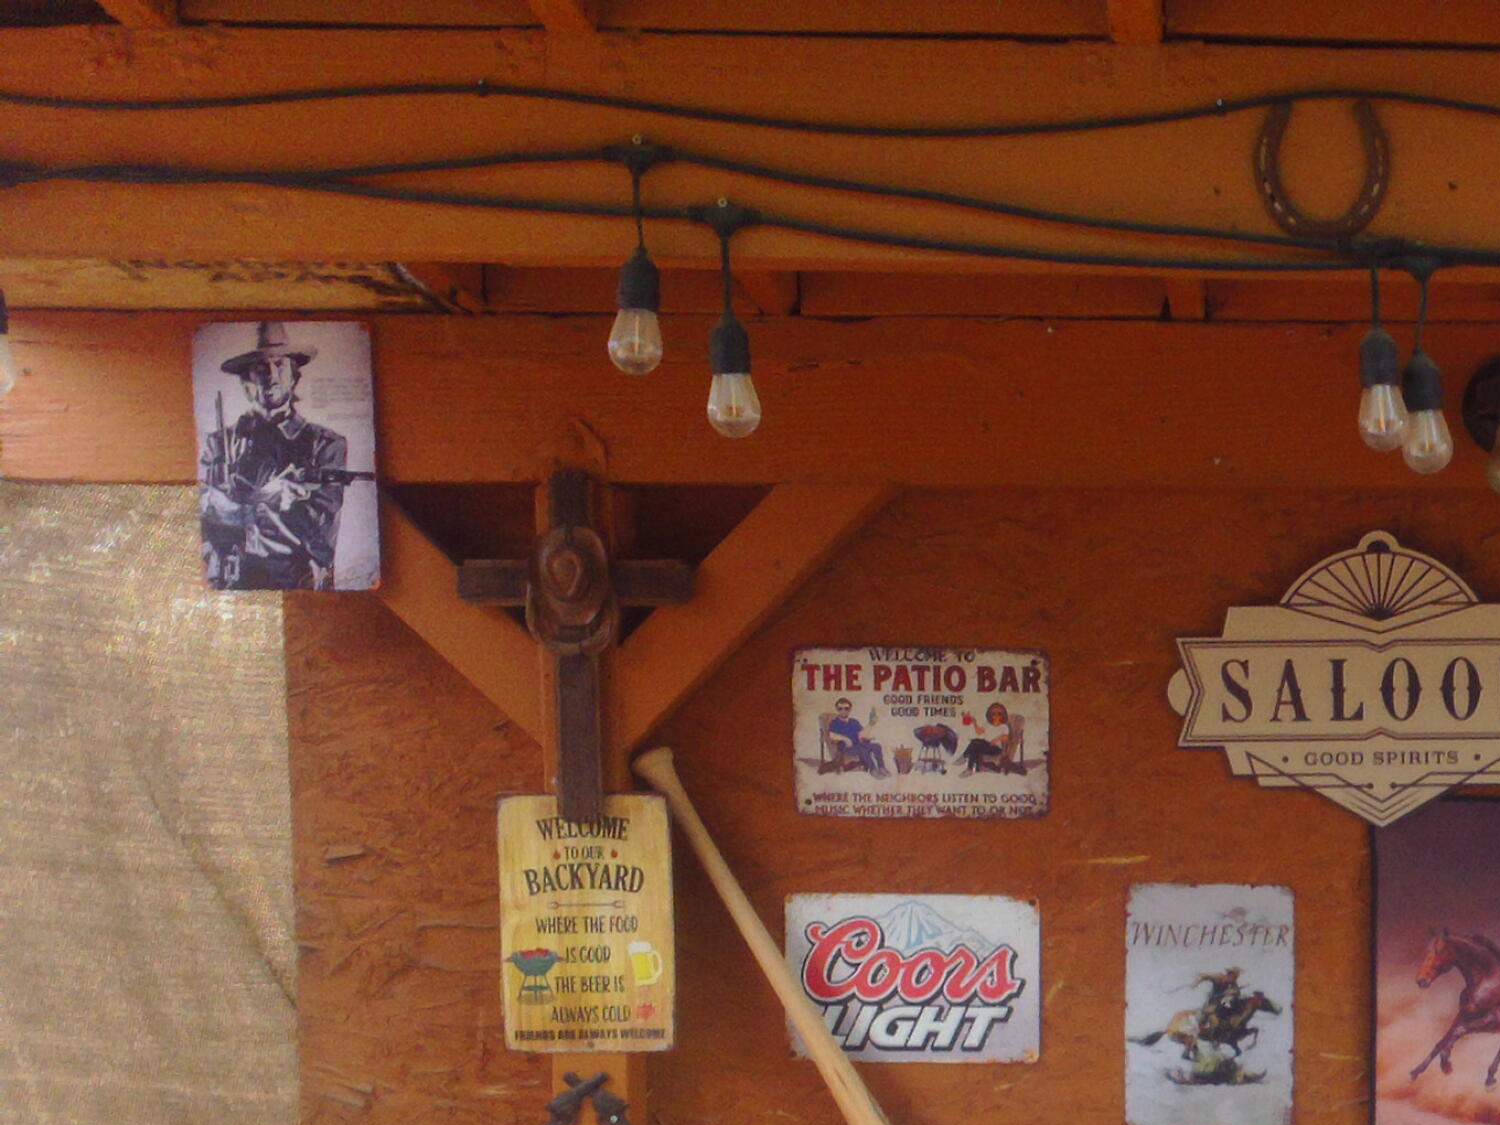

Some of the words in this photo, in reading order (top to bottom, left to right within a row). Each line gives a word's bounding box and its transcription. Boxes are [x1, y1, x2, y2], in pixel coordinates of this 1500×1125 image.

[869, 648, 947, 662] WELCOME
[957, 651, 976, 663] TO
[802, 664, 863, 692] THE
[873, 664, 967, 692] PATIO
[977, 665, 1042, 693] BAR
[883, 695, 913, 706] GOOD
[917, 695, 964, 706] FRIENDS
[890, 707, 919, 718] GOOD
[923, 707, 957, 718] TIMES
[1303, 751, 1365, 768] GOOD
[1372, 749, 1460, 767] SPIRITS
[942, 793, 979, 804] LISTEN
[983, 793, 997, 804] TO
[535, 815, 630, 842] WELCOME
[564, 845, 579, 860] TO
[582, 845, 605, 860] OUR
[524, 862, 645, 896] BACKYARD
[535, 916, 579, 935] WHERE
[583, 915, 604, 934] THE
[609, 914, 638, 933] FOOD
[1132, 921, 1291, 949] WINCHESTER
[566, 946, 577, 964] IS
[579, 946, 611, 964] GOOD
[802, 915, 1026, 1006] Coors
[554, 976, 575, 994] THE
[580, 975, 612, 994] BEER
[614, 974, 625, 993] IS
[551, 1006, 600, 1024] ALWAYS
[602, 1004, 631, 1023] COLD
[821, 1004, 1013, 1051] LIGHT
